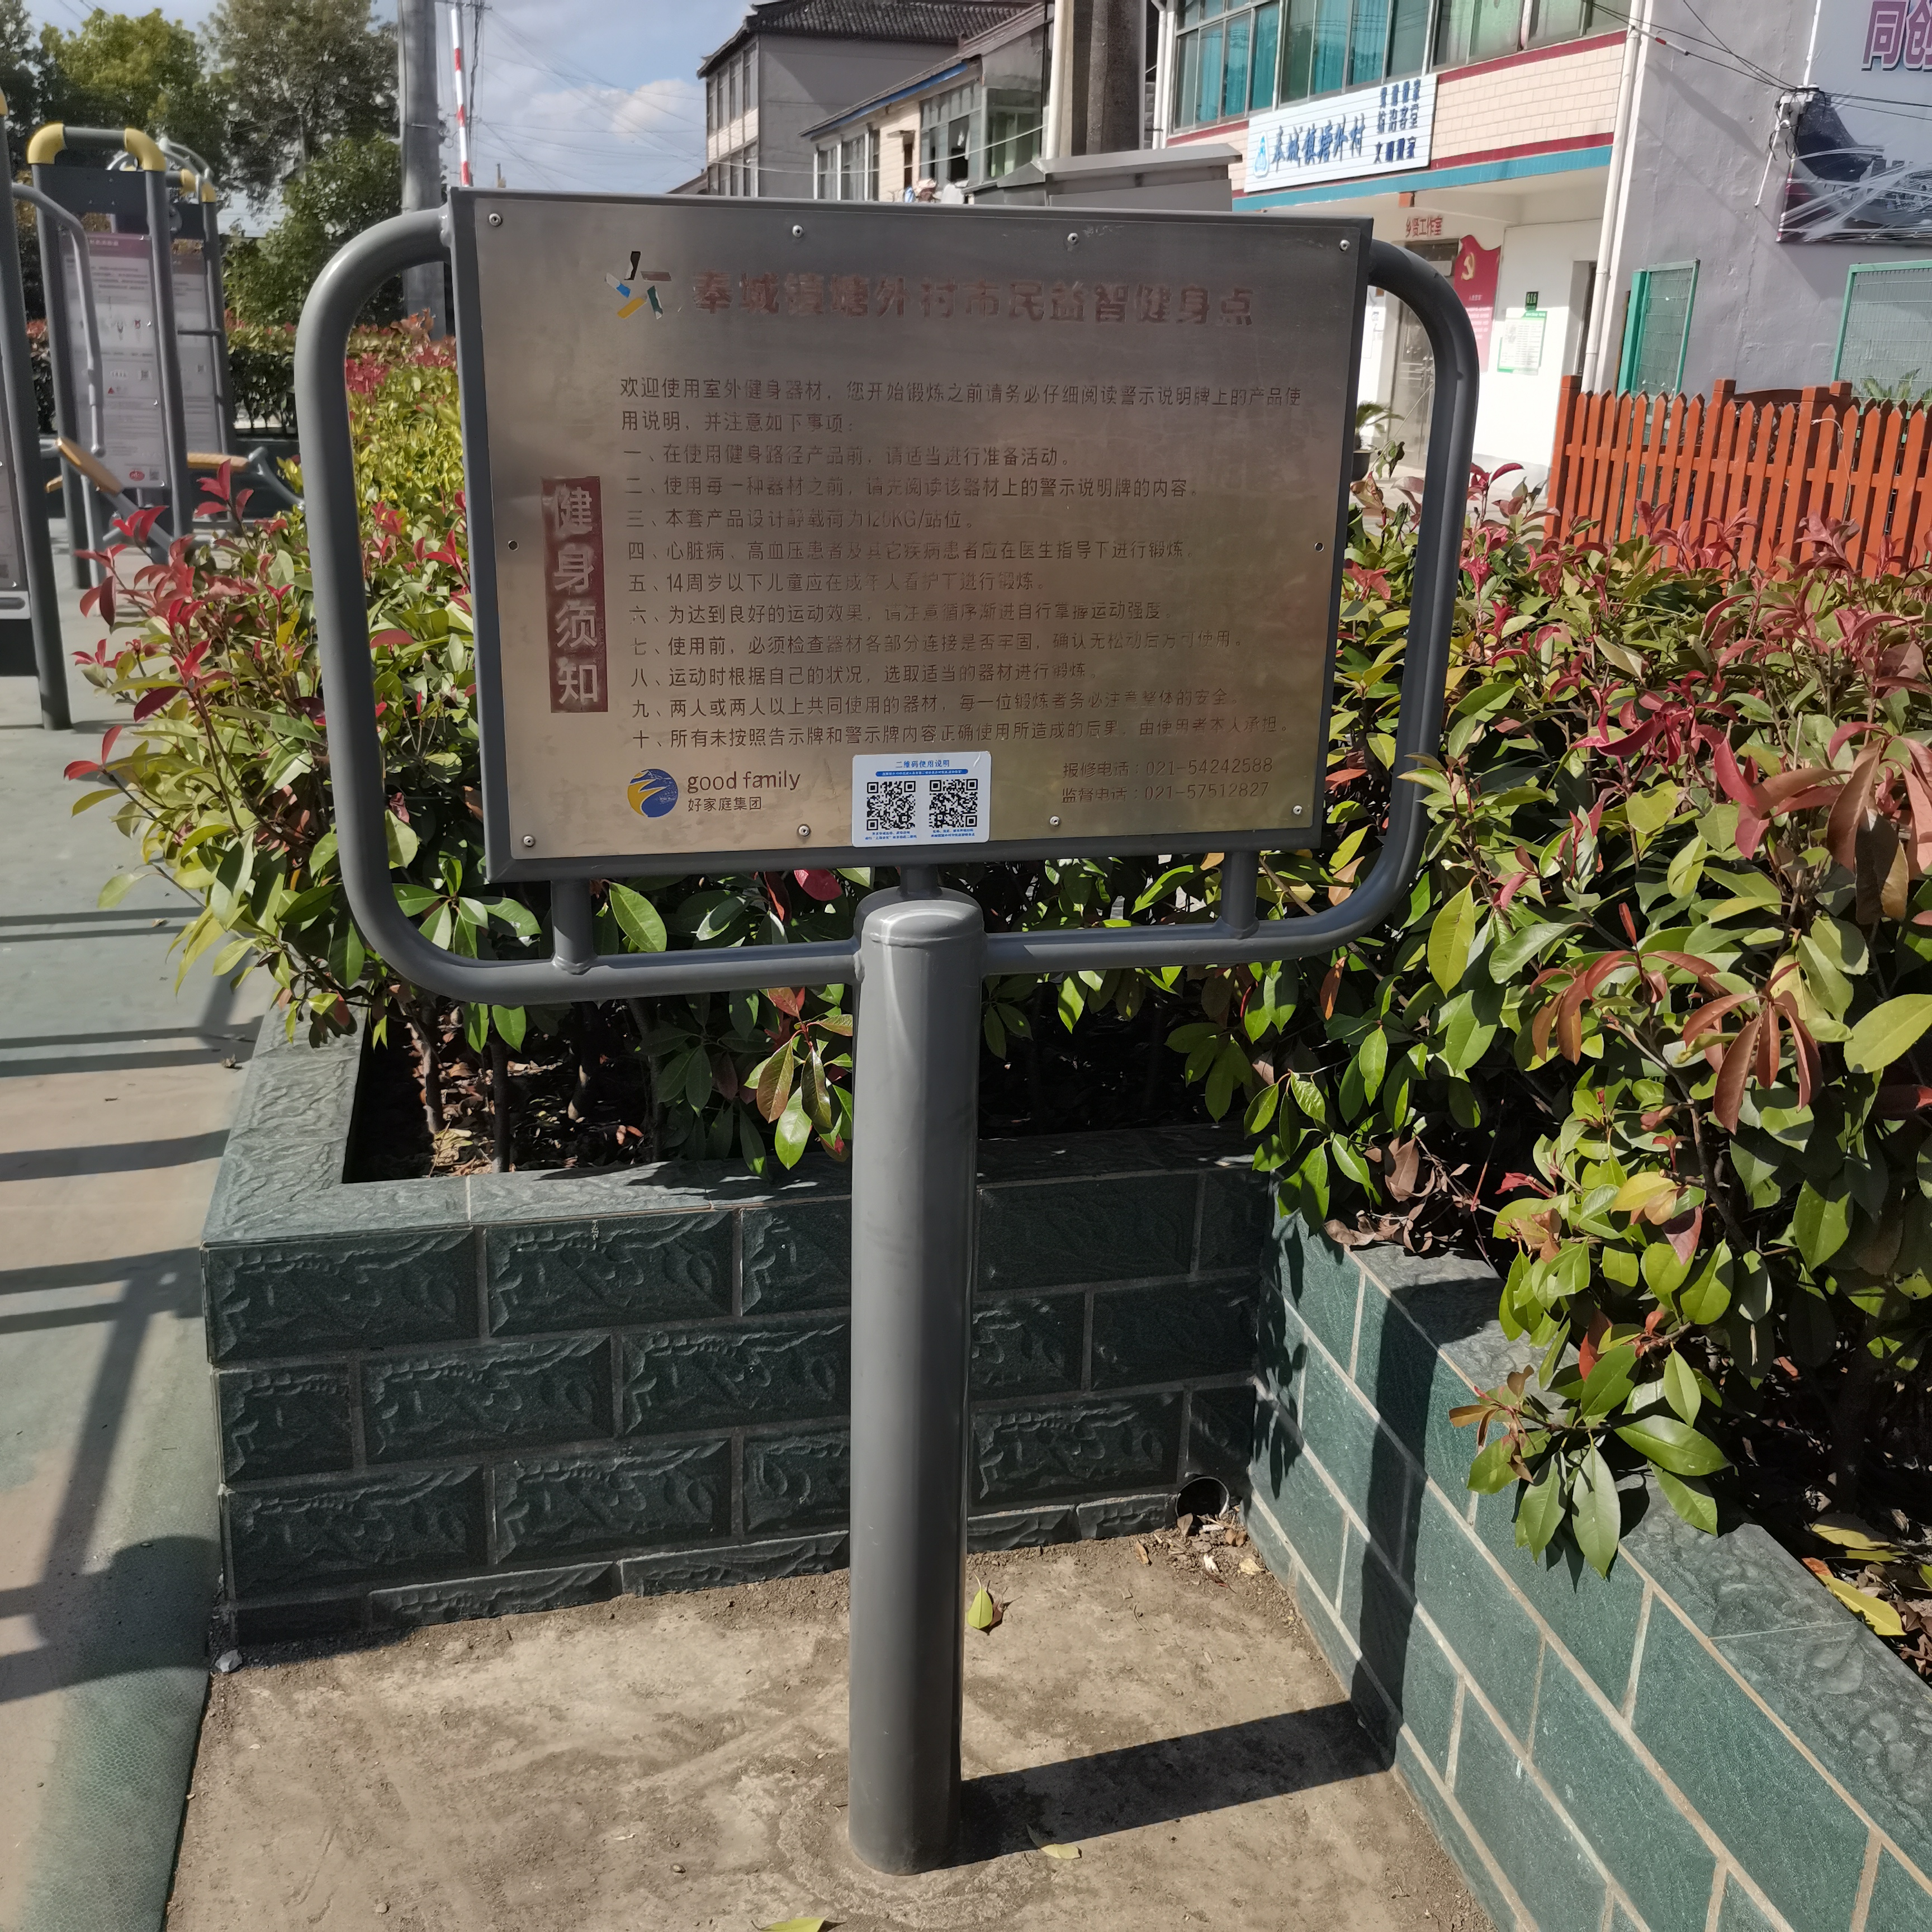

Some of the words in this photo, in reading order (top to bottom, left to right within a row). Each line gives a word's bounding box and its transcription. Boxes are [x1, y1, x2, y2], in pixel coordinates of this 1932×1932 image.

[1405, 216, 1443, 238] 乡贤工作室
[553, 484, 598, 704] 健身须知
[895, 759, 950, 769] 二维码使用说明
[688, 771, 737, 794] good
[744, 769, 801, 791] family
[688, 796, 763, 812] 好家庭集团
